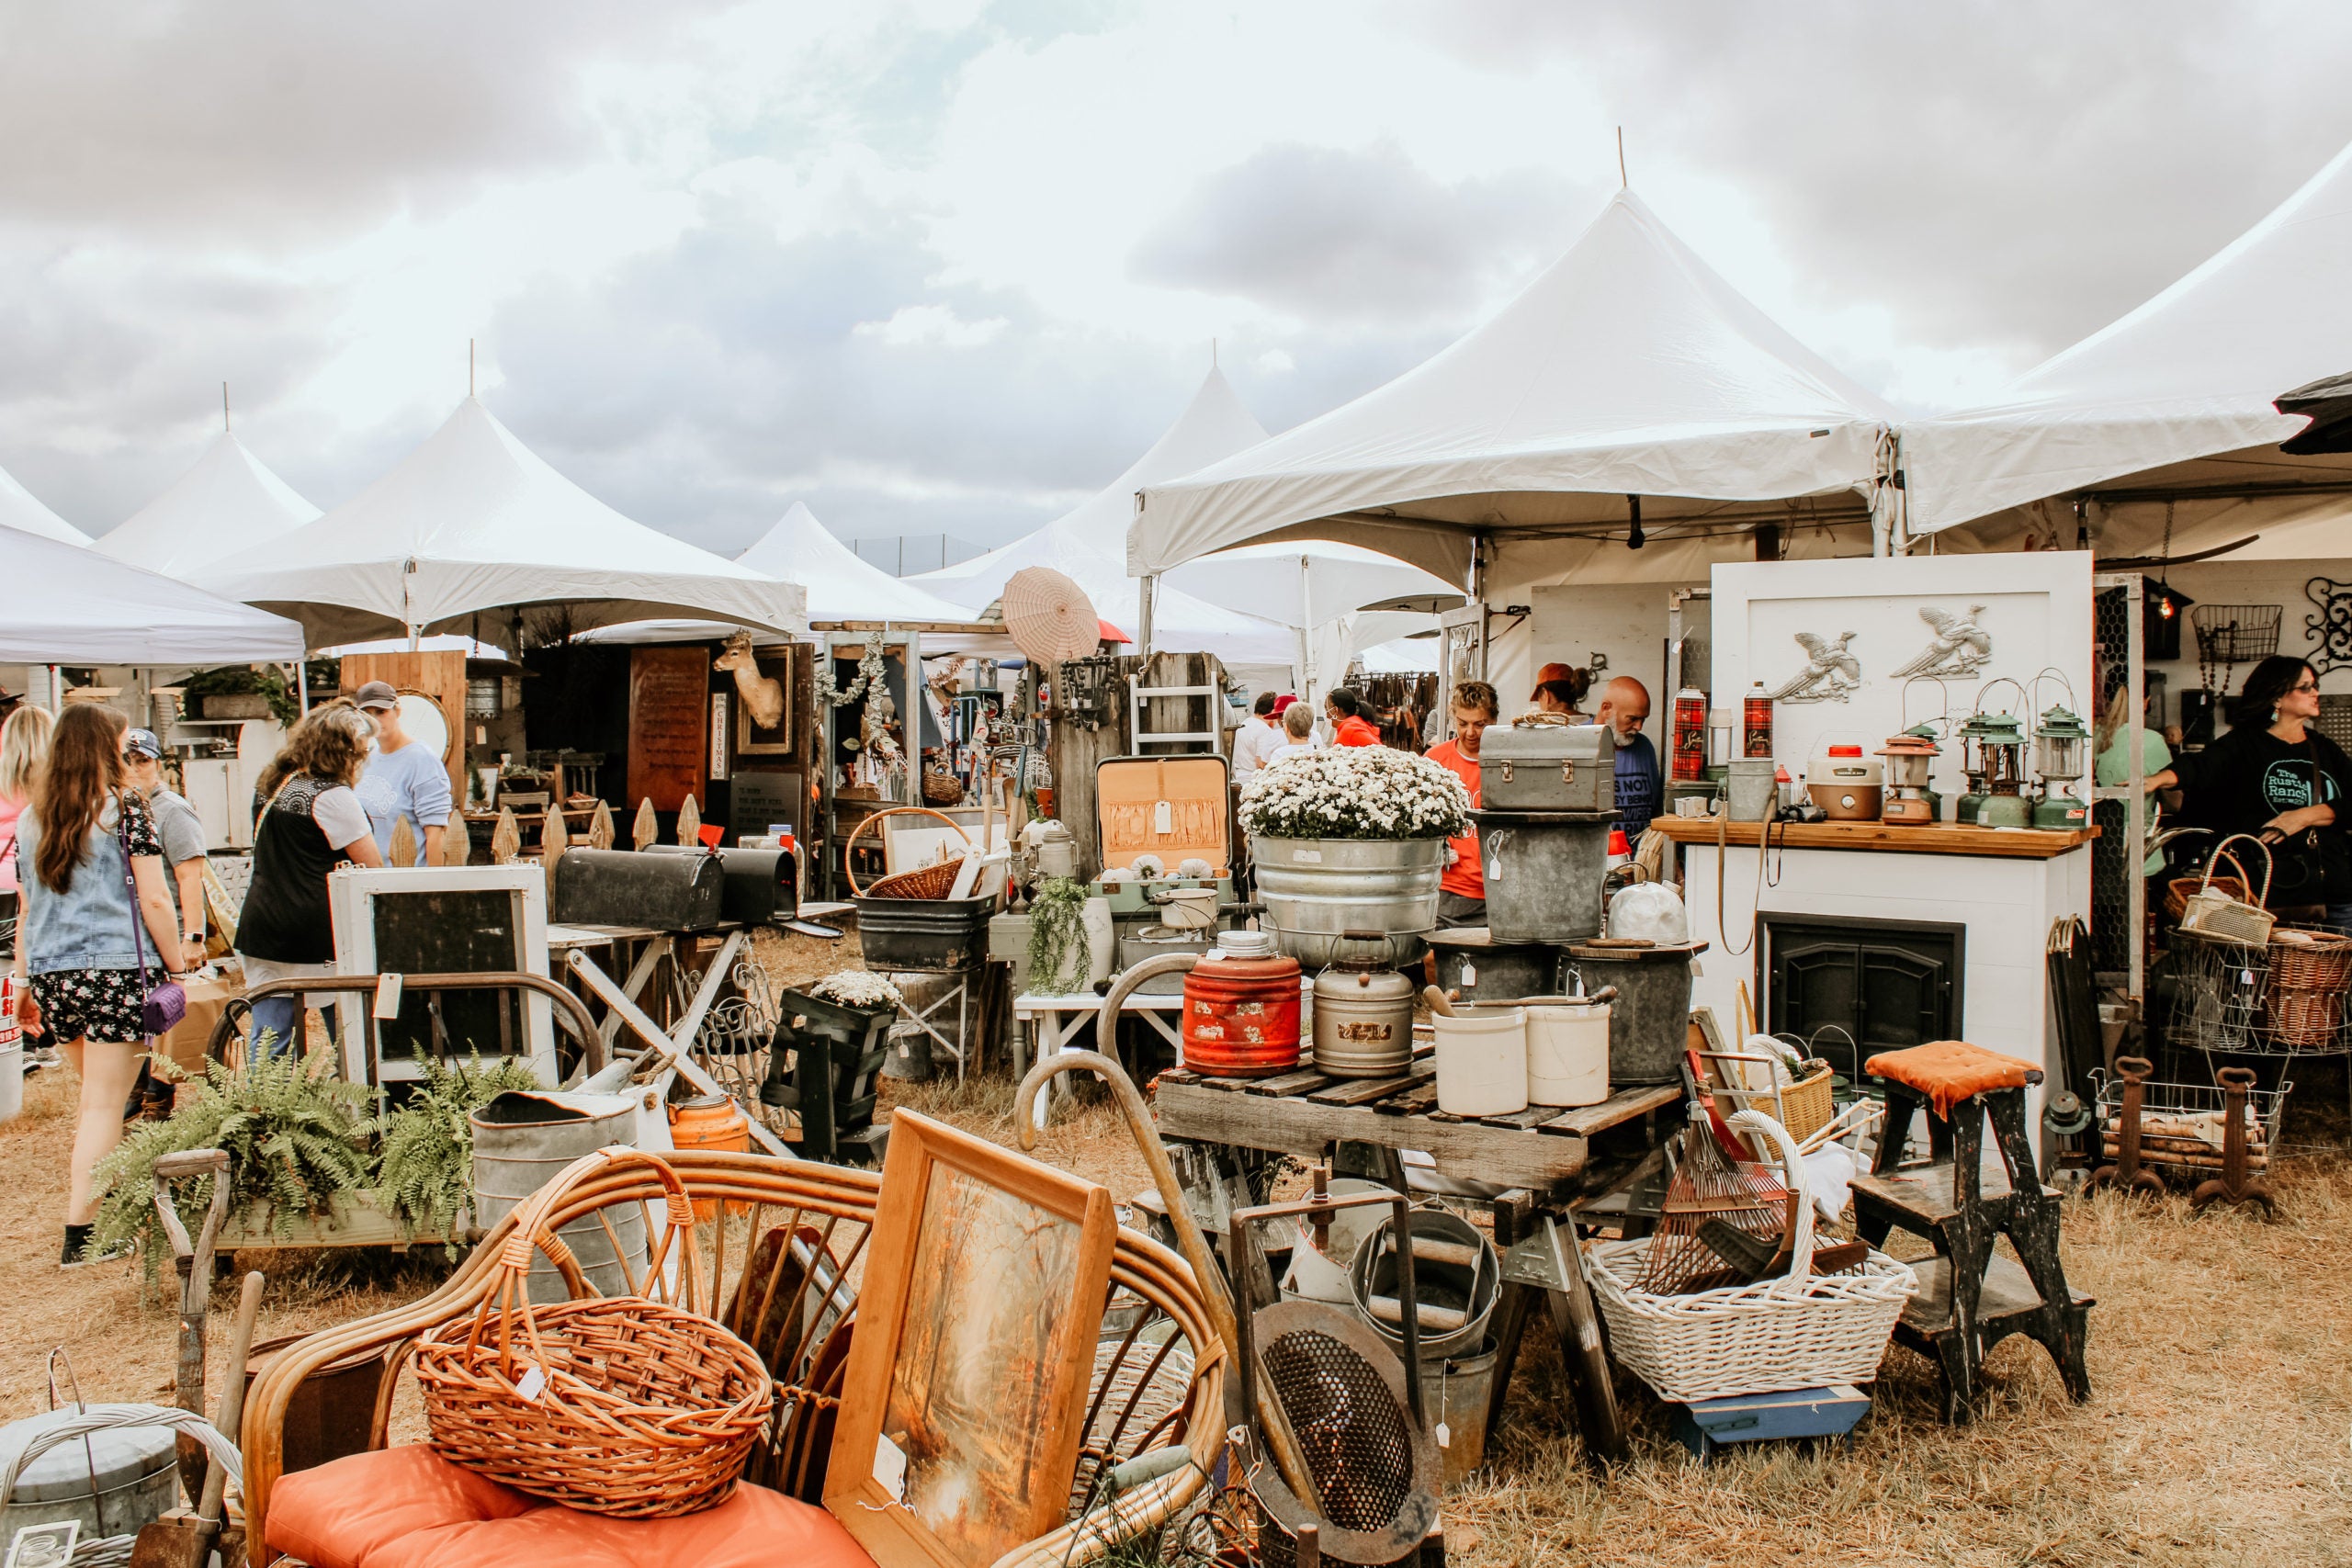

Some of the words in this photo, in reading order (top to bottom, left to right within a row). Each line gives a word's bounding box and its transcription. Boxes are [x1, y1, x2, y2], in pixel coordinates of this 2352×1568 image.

[2277, 769, 2299, 780] The
[1623, 779, 1648, 792] NOT
[2268, 776, 2308, 790] Rustic
[2268, 785, 2307, 801] Ranch
